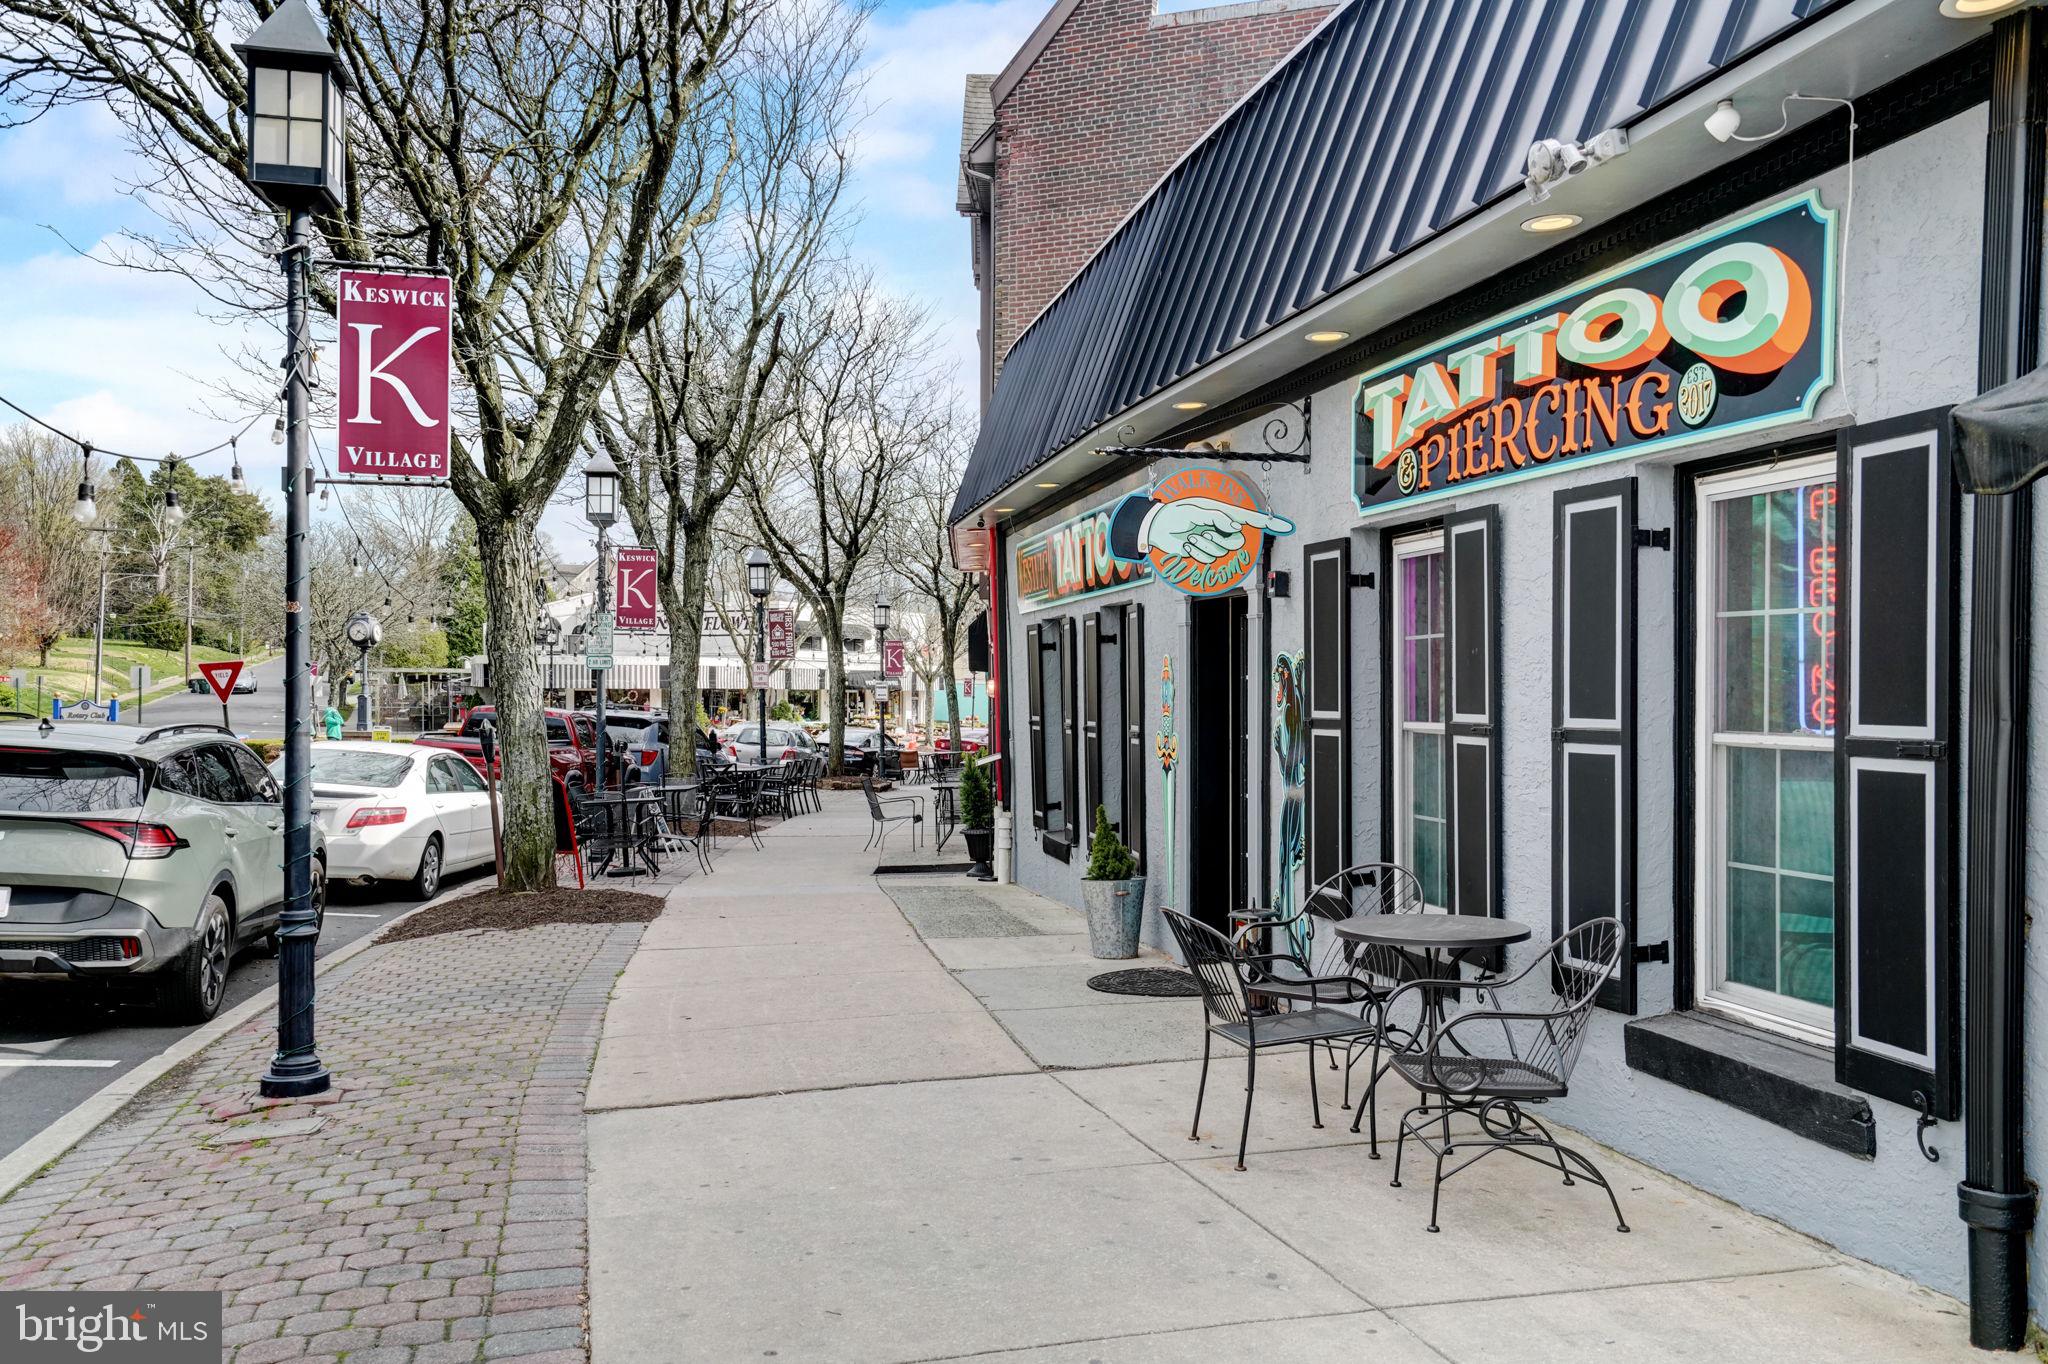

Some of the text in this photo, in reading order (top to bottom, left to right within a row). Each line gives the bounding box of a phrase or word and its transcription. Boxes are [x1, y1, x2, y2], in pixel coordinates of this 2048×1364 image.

[343, 279, 446, 307] KESWICK
[1364, 241, 1812, 470] TATTOO
[347, 322, 441, 428] K
[1686, 366, 1708, 384] EST.
[1680, 379, 1713, 418] 2017
[1399, 371, 1673, 489] & PIERCING
[345, 446, 442, 469] VILLAGE
[1160, 472, 1246, 505] WALK-INS
[619, 552, 656, 562] KESWICK
[1160, 550, 1251, 591] Welcome
[619, 568, 654, 609] K
[618, 616, 654, 625] VILLAGE
[785, 611, 794, 658] FIRST FRIDAY
[887, 648, 902, 668] K
[67, 711, 105, 720] Rotary Club
